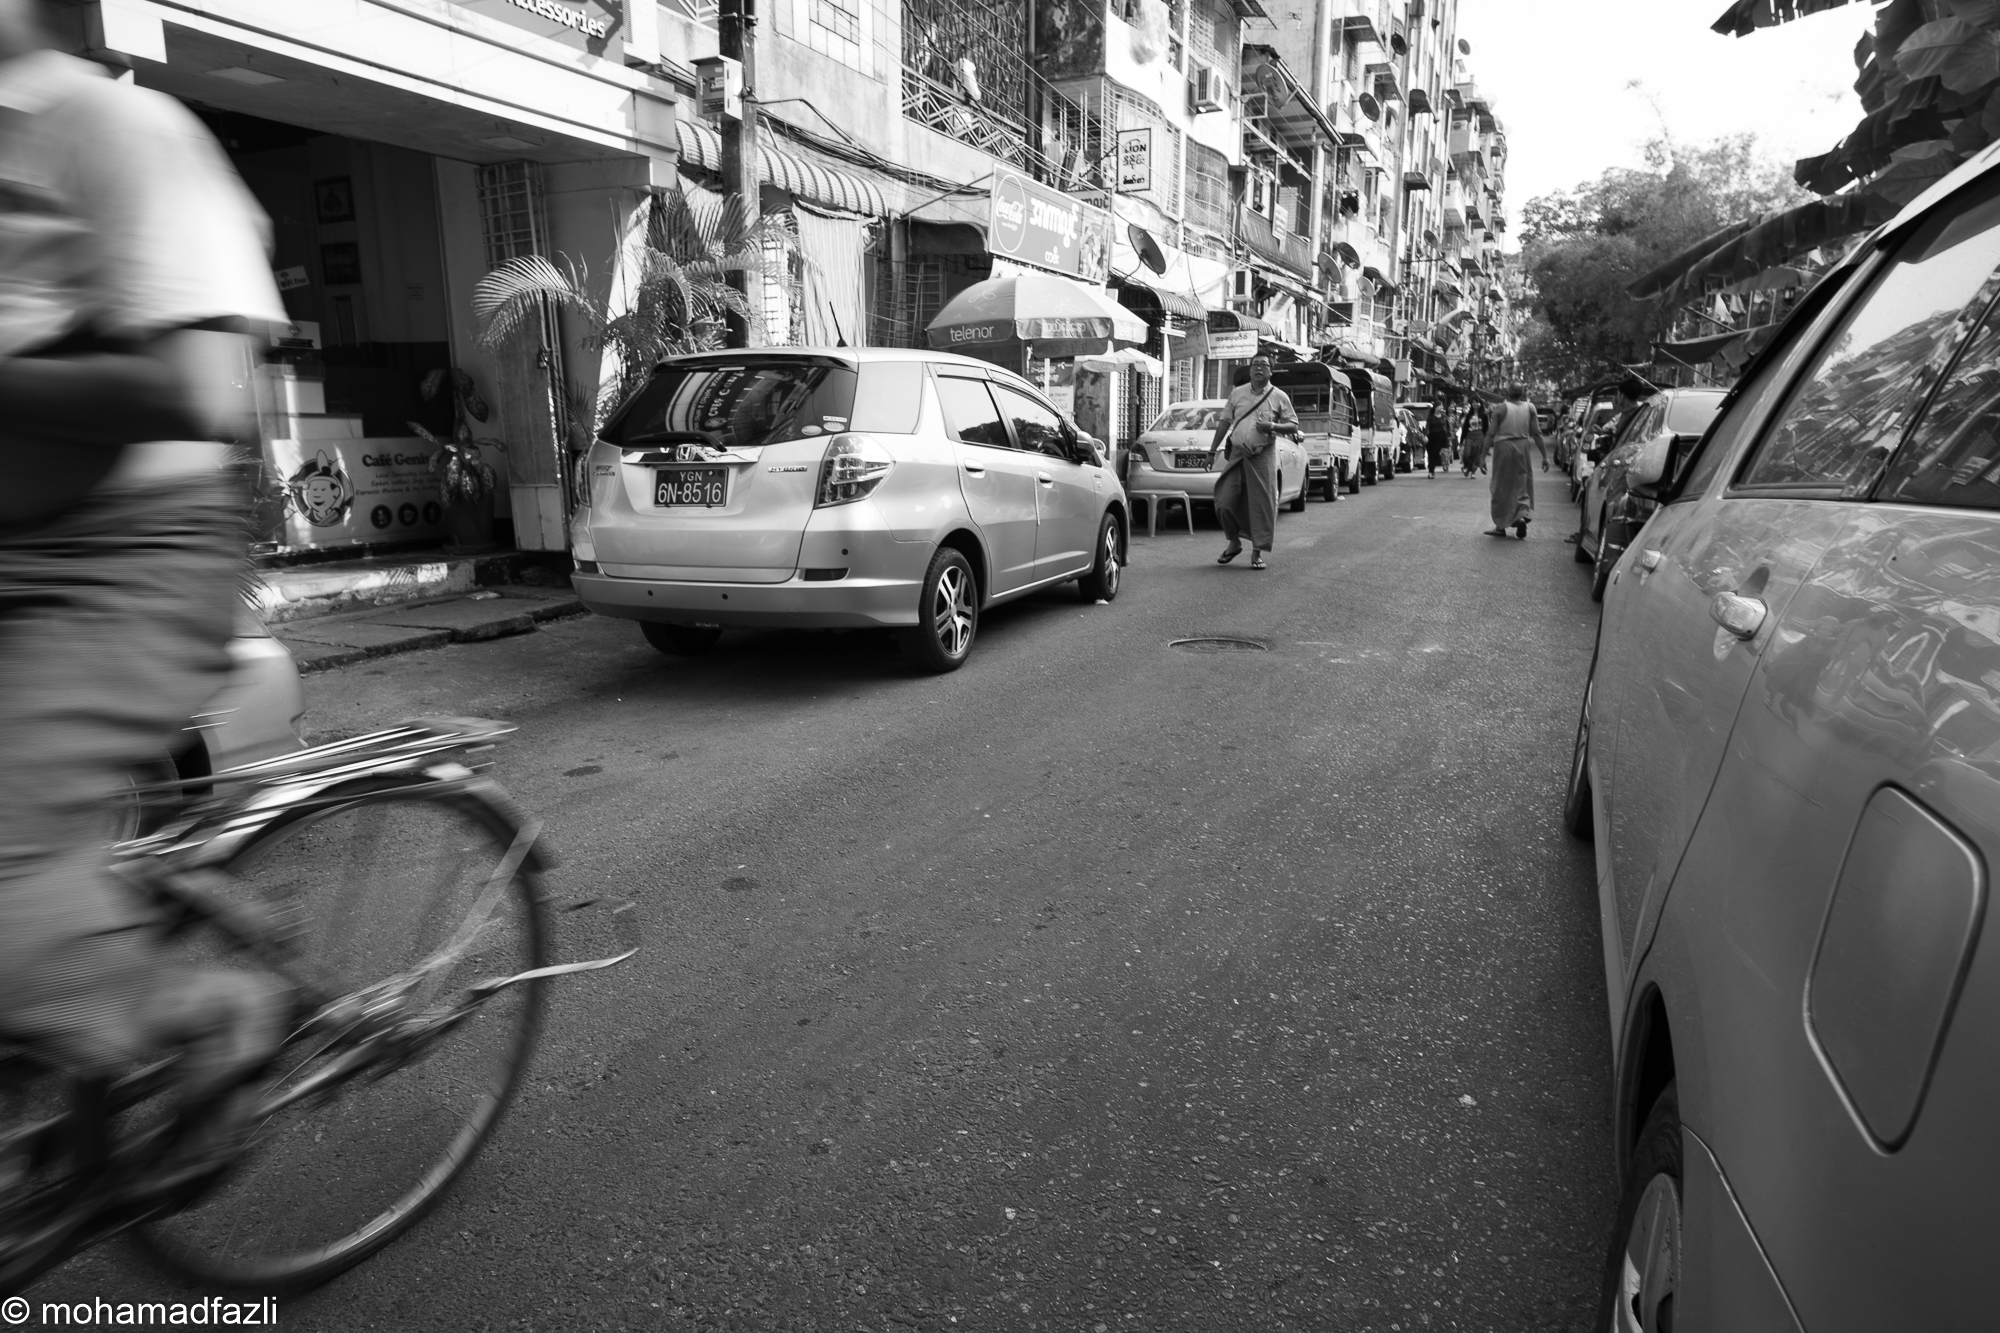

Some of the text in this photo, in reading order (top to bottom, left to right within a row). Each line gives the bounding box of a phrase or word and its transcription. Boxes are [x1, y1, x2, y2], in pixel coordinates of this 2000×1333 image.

[506, 0, 606, 38] cessories
[950, 324, 995, 343] telenor
[362, 452, 441, 467] Café Geni
[679, 471, 703, 482] YGN
[657, 482, 722, 504] 6N-8516
